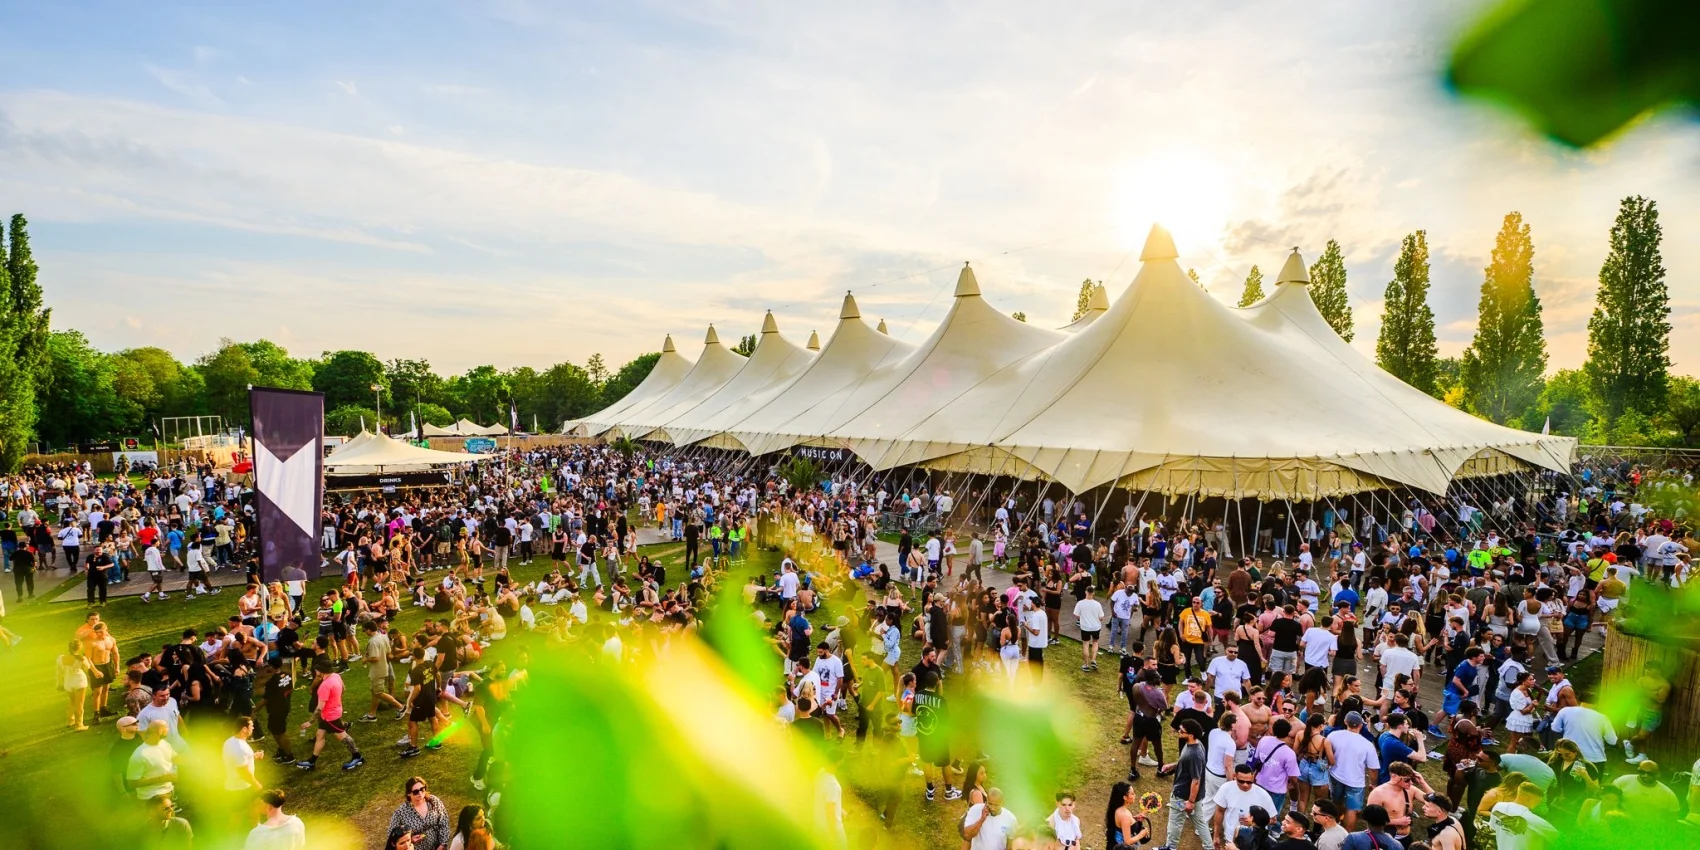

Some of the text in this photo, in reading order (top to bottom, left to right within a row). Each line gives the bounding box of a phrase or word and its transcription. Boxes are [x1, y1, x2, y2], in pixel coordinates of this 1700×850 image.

[801, 448, 843, 460] MUSIC ON
[915, 693, 940, 708] NIRVANA
